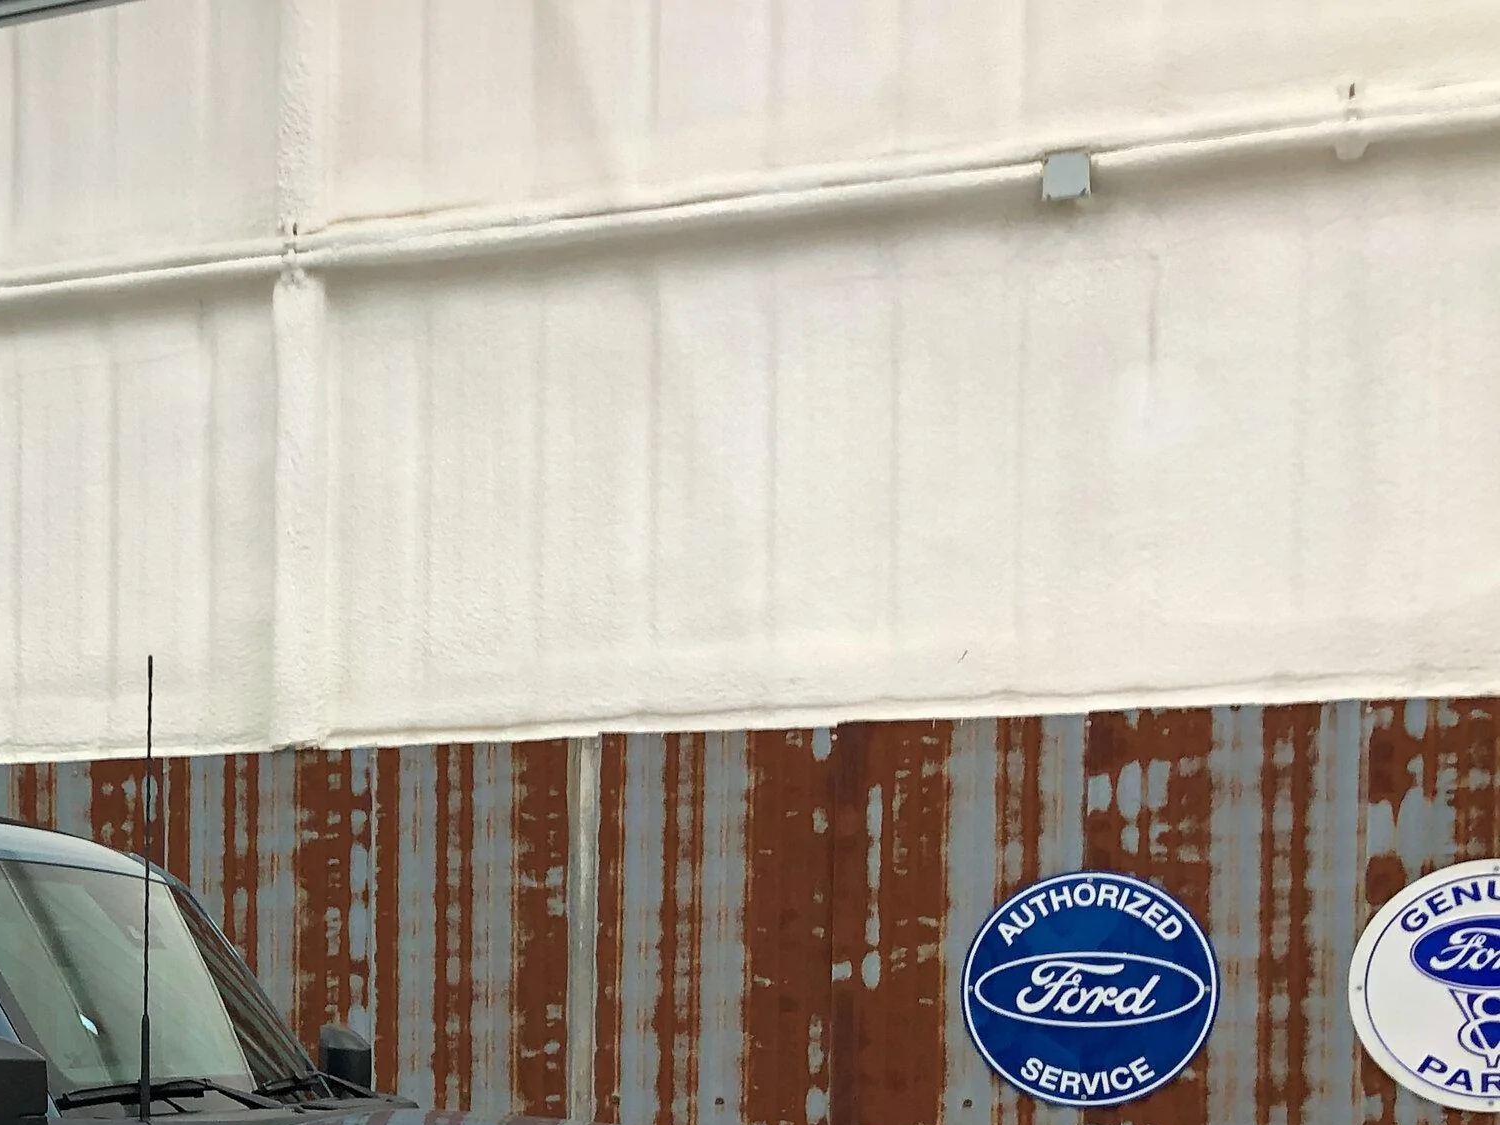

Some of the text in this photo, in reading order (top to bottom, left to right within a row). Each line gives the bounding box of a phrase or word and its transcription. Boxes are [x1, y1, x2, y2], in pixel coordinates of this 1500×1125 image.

[997, 882, 1183, 946] AUTHORIZED
[1015, 960, 1161, 1015] Ford
[1020, 1056, 1156, 1095] SERVICE
